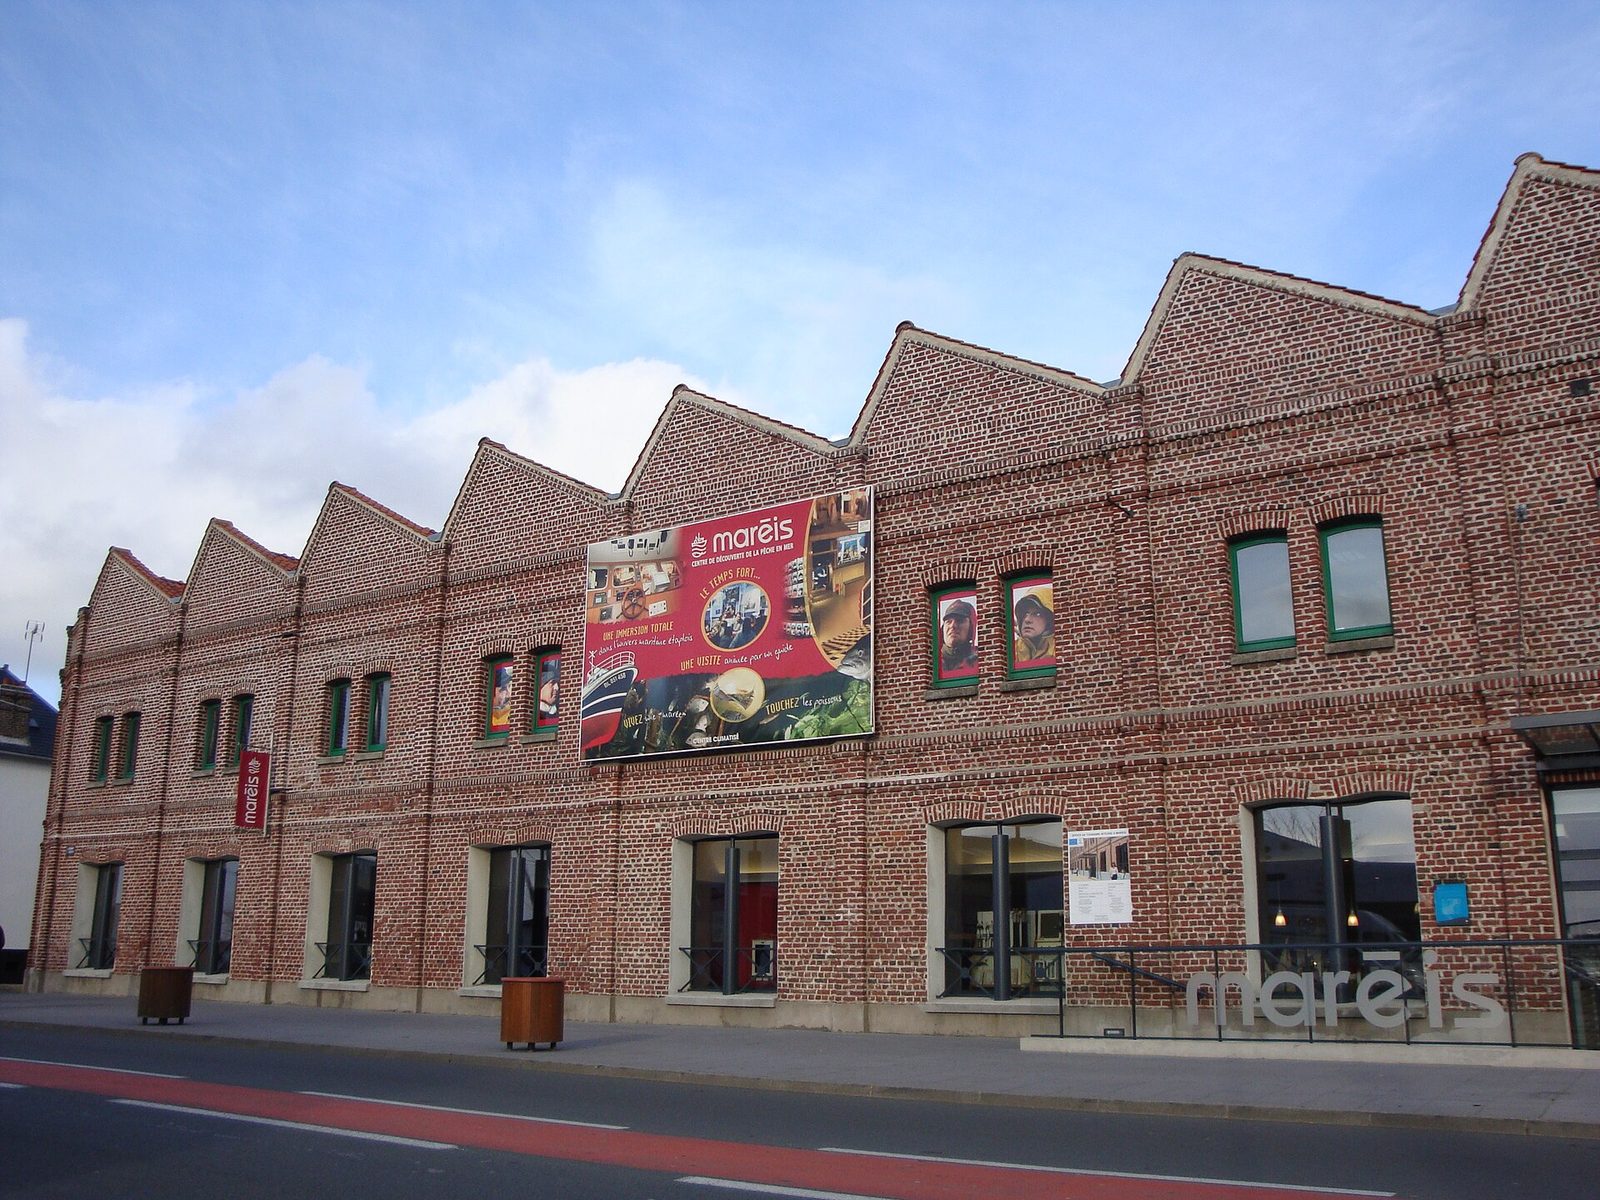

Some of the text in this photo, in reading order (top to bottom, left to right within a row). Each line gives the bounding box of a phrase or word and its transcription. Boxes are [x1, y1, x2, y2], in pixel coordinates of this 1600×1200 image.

[691, 558, 708, 568] CENTRE
[708, 557, 716, 565] DE
[716, 552, 745, 563] DÉCOUVERTE
[745, 551, 753, 559] DE
[752, 549, 760, 557] LA
[760, 546, 775, 555] PÊCHE
[783, 542, 794, 550] MER
[699, 587, 710, 600] LE
[709, 569, 734, 589] TEMPS
[602, 621, 674, 641] UNE IMMERSION TOTALE
[598, 645, 613, 656] dans
[680, 658, 694, 671] UNE
[697, 655, 722, 667] VISITE
[749, 653, 763, 665] par
[765, 695, 843, 715] TOUCHEZ les poissons
[623, 714, 643, 729] VIVEZ
